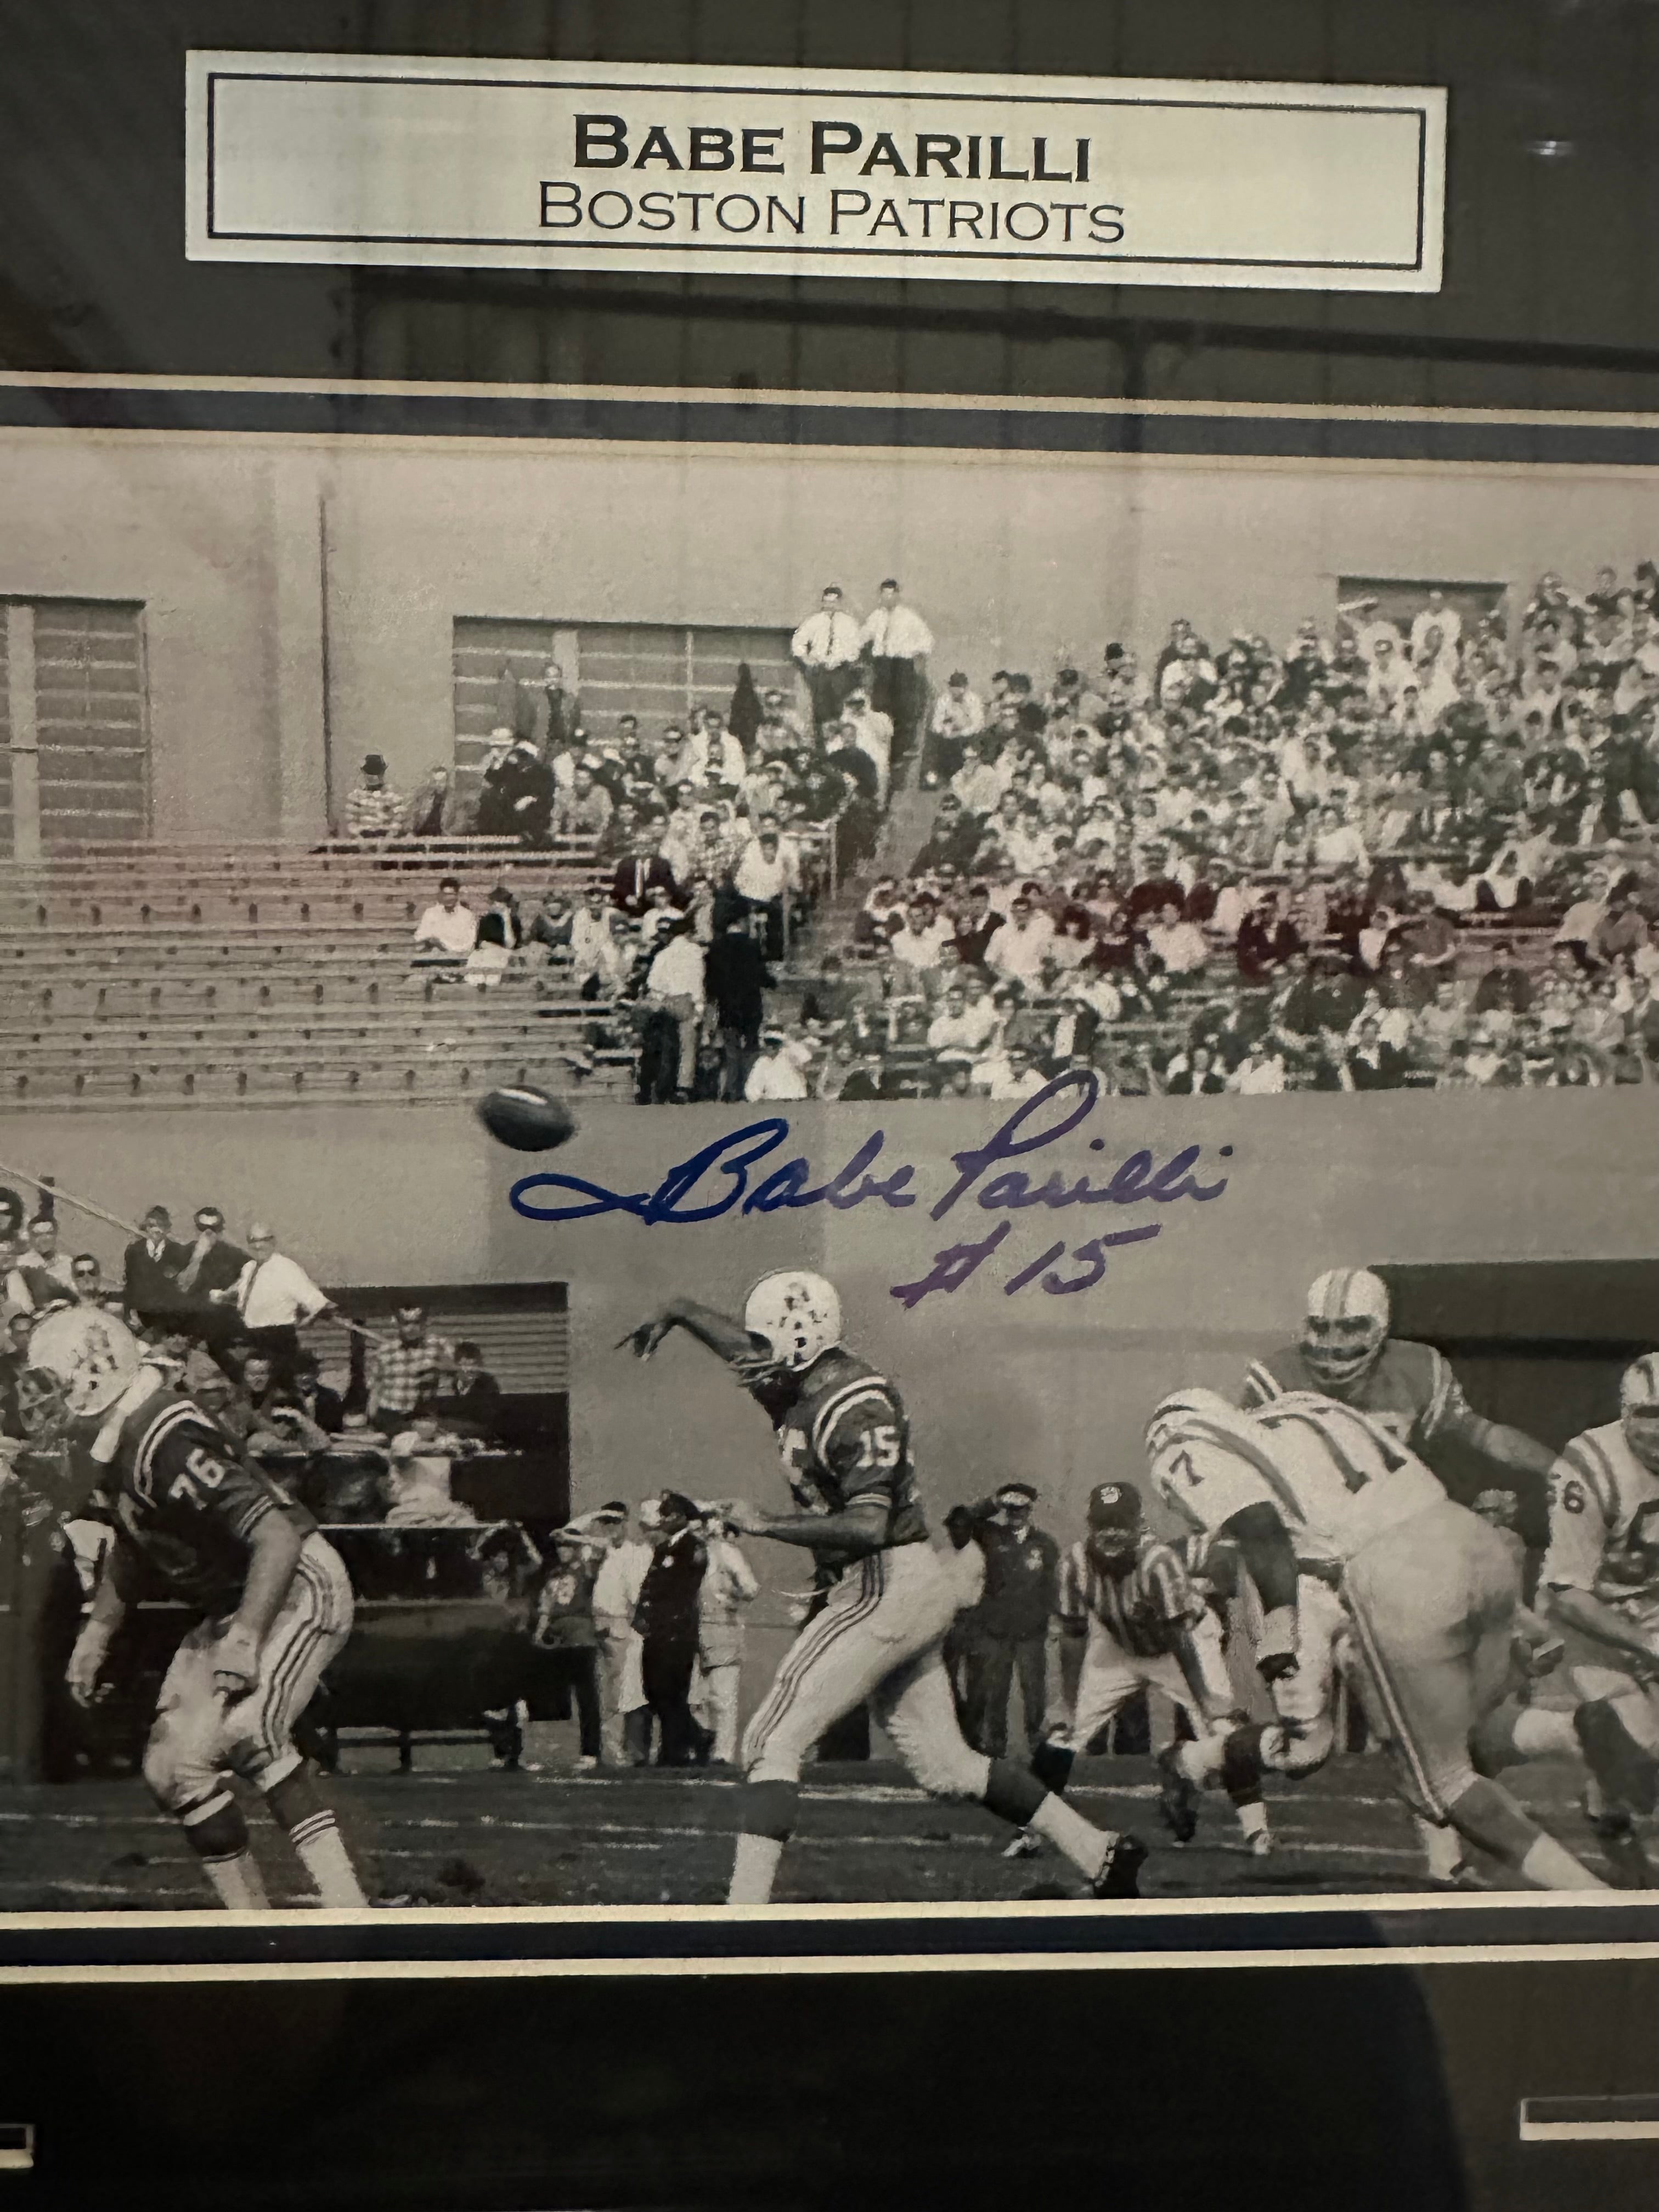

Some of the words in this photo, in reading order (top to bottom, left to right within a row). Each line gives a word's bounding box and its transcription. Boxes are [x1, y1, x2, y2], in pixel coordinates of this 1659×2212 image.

[573, 114, 785, 175] BABE
[810, 120, 1091, 183] PARILLI
[539, 182, 805, 235] BOSTON
[830, 189, 1126, 244] PATRIOTS
[509, 1118, 916, 1226] Babe
[856, 1425, 901, 1468] 15
[169, 1448, 226, 1510] 76
